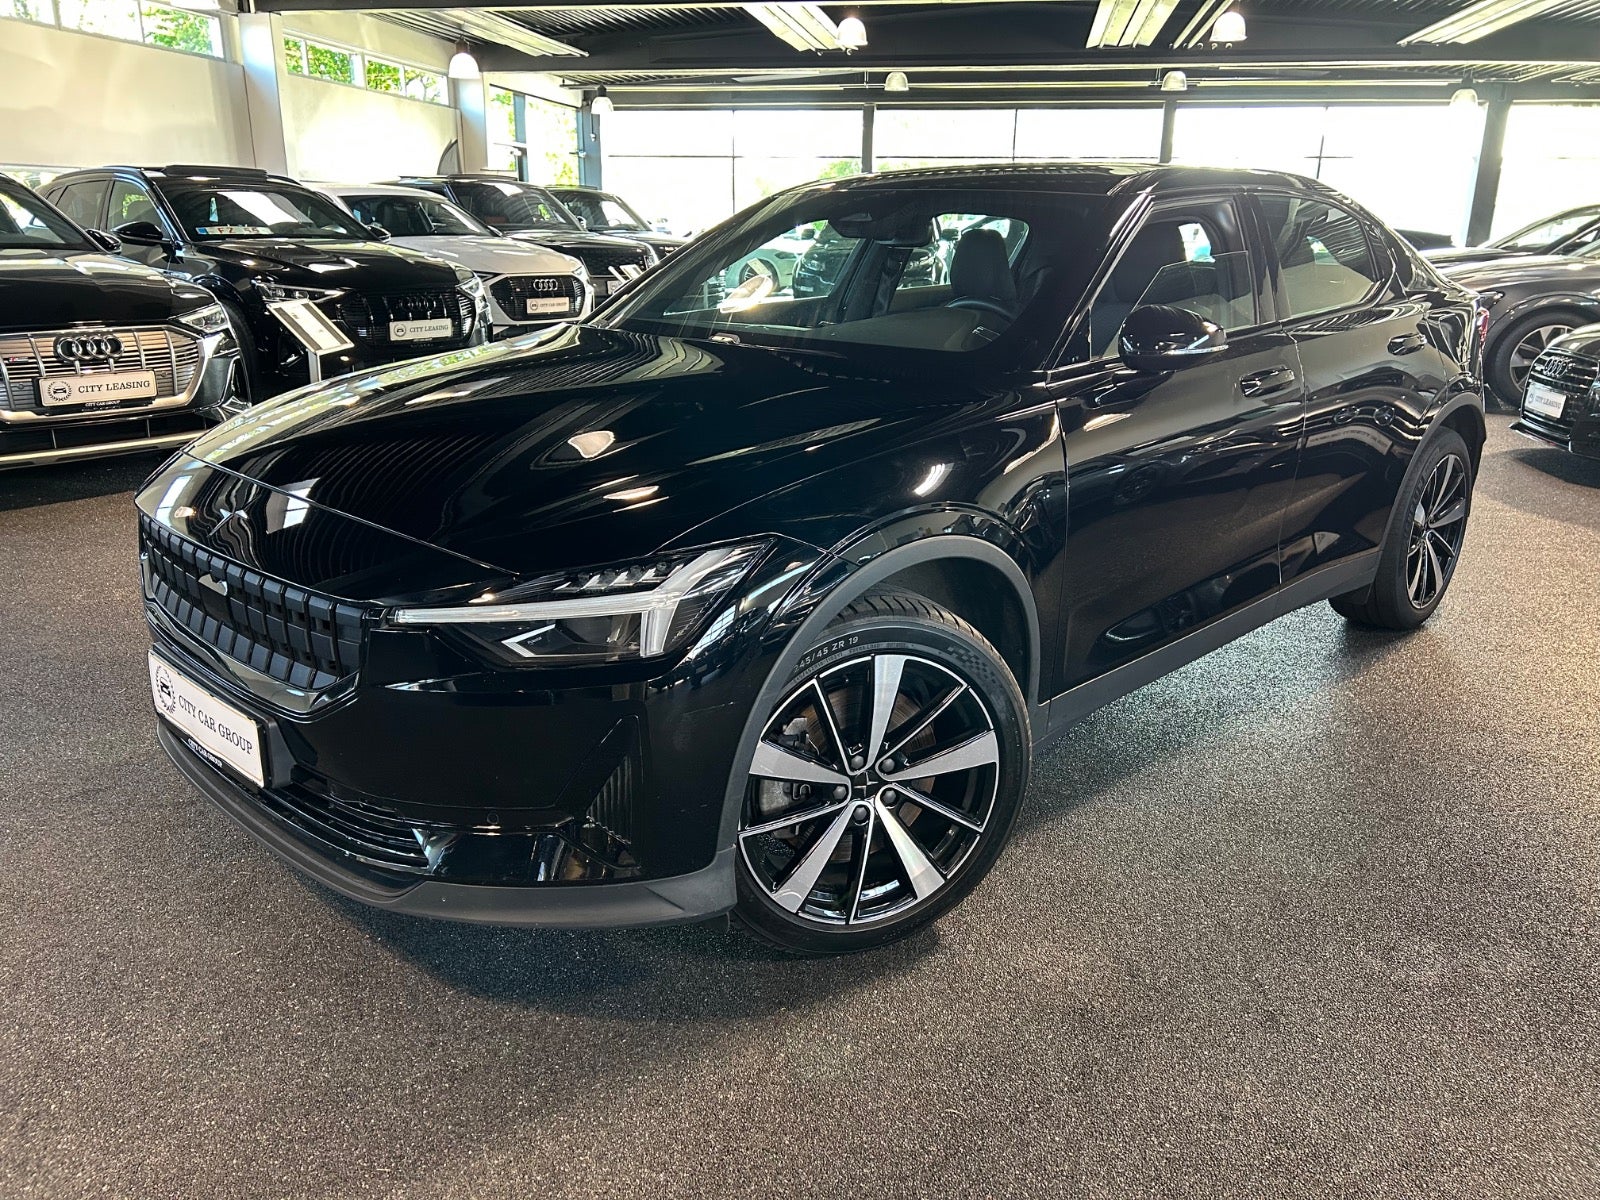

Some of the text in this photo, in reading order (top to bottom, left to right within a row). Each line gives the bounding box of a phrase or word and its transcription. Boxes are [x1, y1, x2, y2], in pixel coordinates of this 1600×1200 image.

[424, 324, 449, 332] LEASING
[78, 380, 151, 394] CITY LEASING
[793, 648, 829, 673] 245/45
[832, 640, 845, 651] ZR
[848, 636, 859, 645] 19
[178, 694, 253, 755] CITY CAR GROUP
